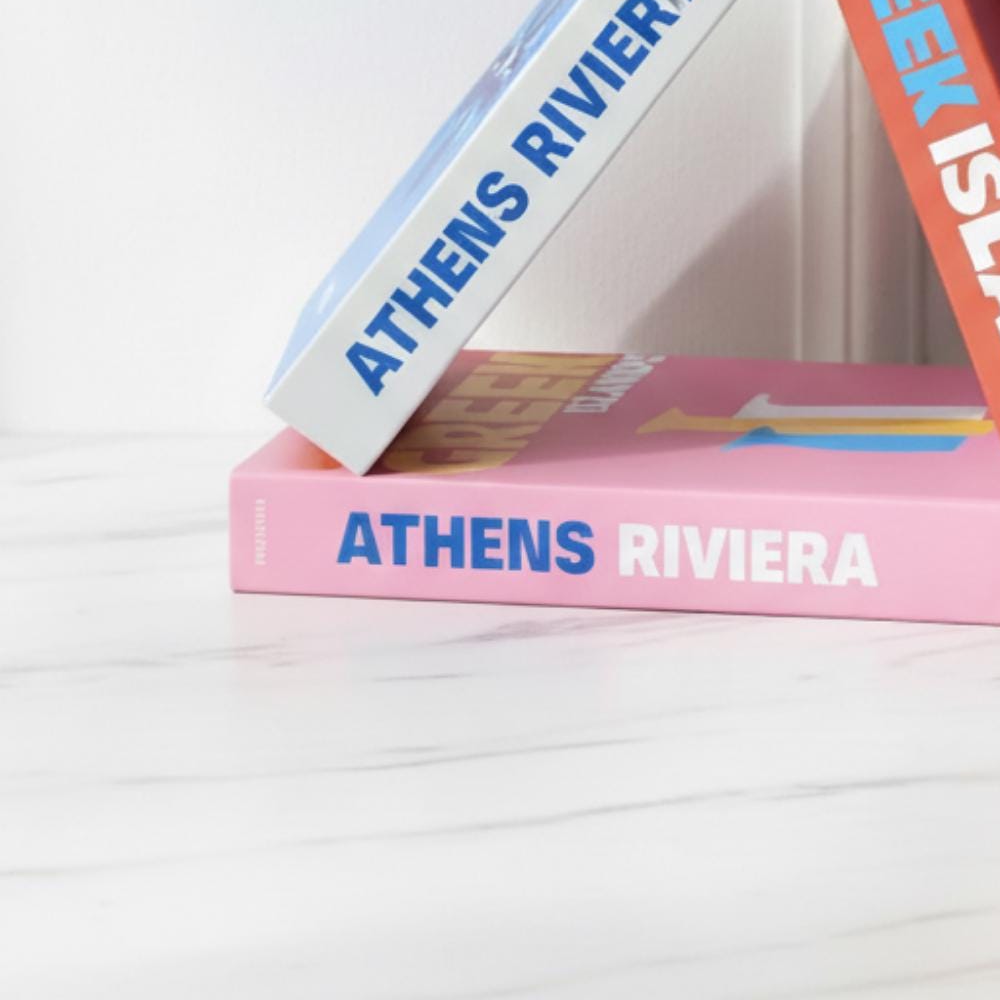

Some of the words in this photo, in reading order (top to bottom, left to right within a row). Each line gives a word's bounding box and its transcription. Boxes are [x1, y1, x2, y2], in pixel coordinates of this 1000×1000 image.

[345, 171, 530, 397] ATHENS
[337, 511, 596, 575] ATHENS
[618, 522, 879, 589] RIVIERA
